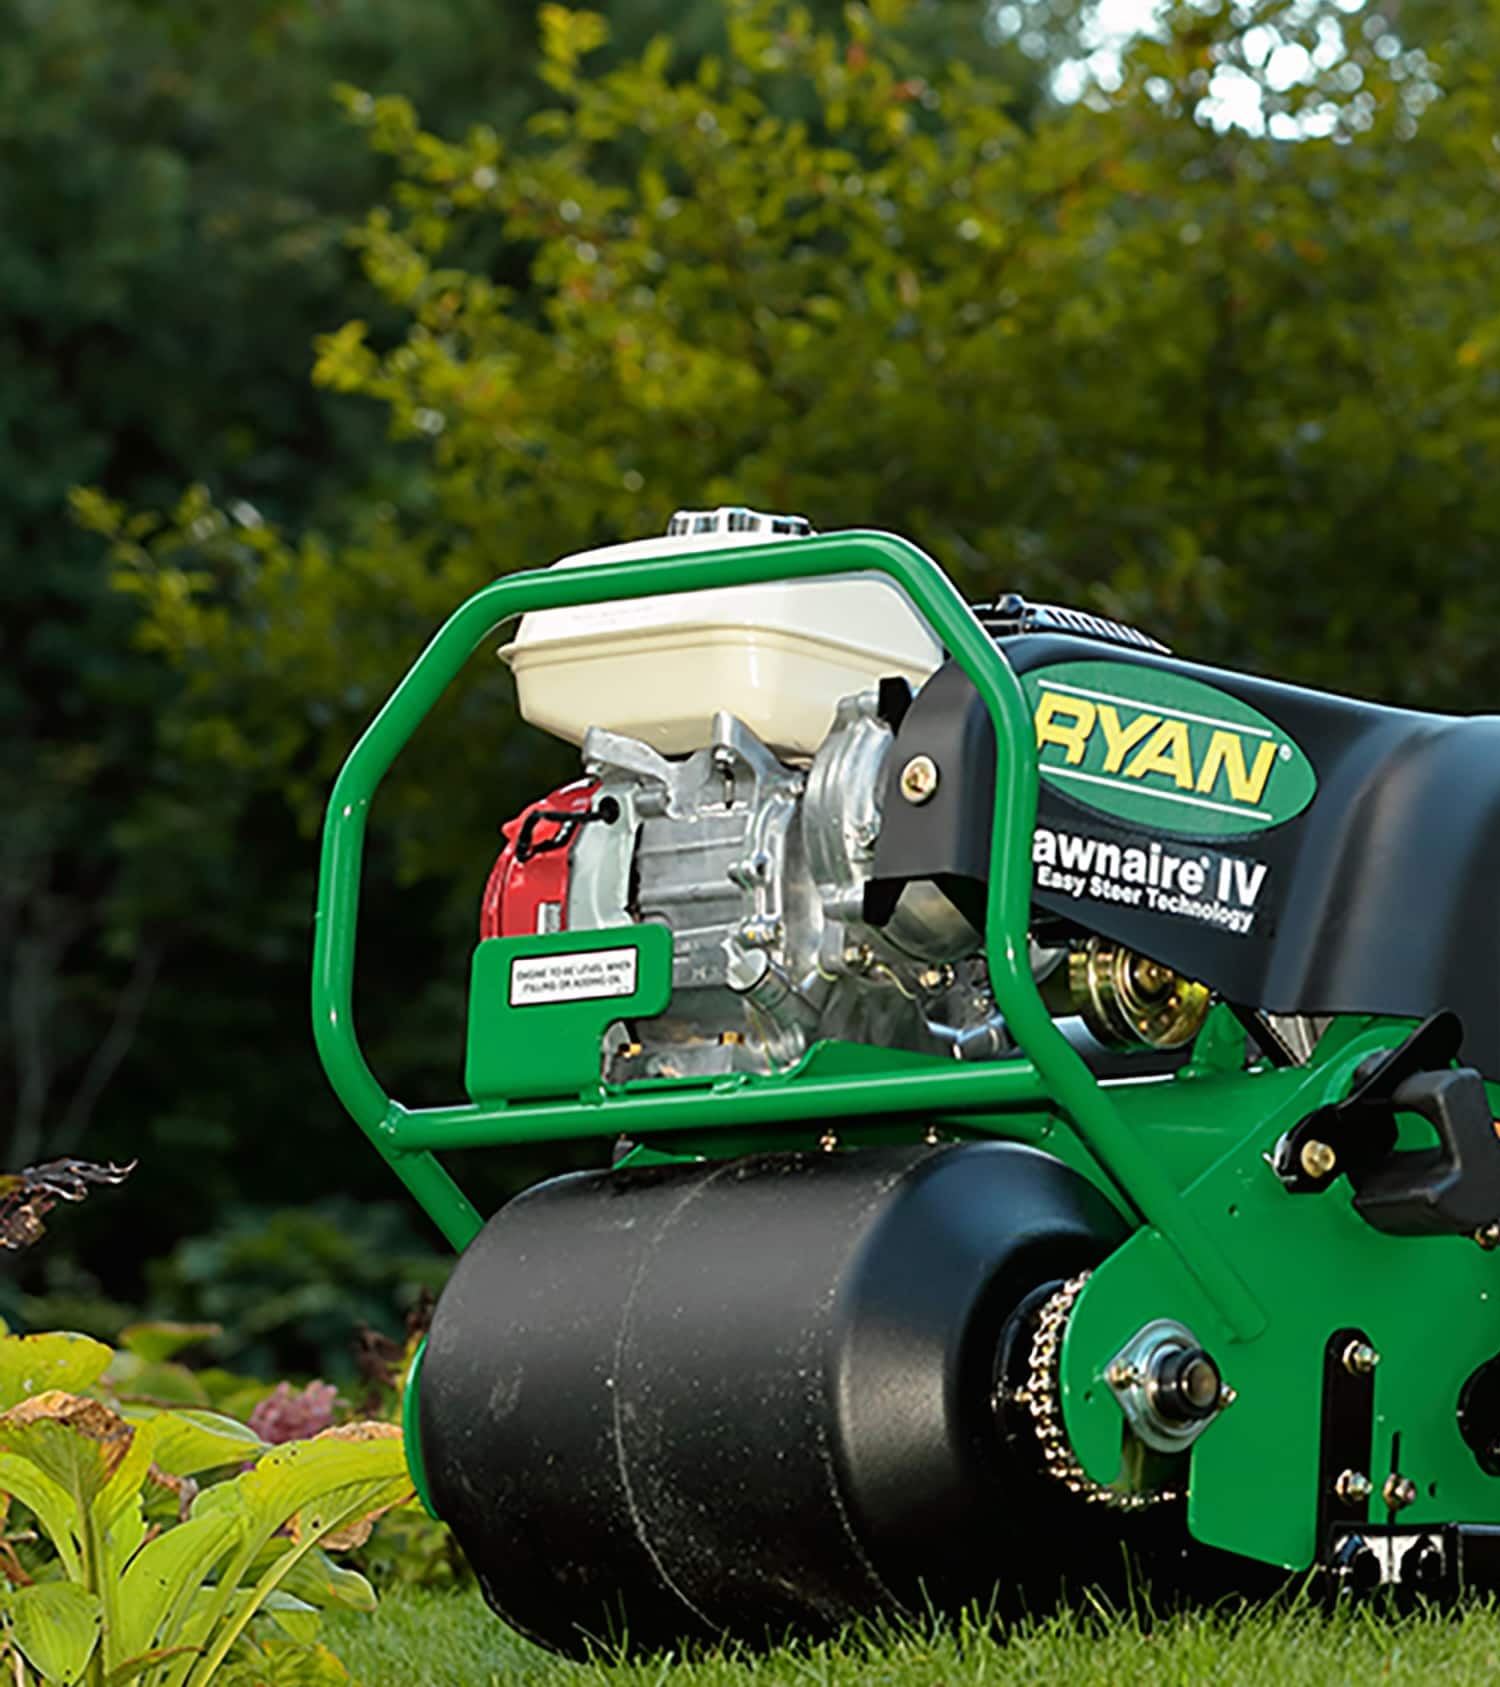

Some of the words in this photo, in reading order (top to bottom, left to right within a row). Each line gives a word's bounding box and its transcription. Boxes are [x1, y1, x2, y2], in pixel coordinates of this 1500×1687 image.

[1034, 691, 1278, 805] RYAN
[1031, 828, 1207, 896] awnaire
[1216, 857, 1268, 908] IV
[1036, 864, 1087, 898] Easy
[1089, 875, 1143, 905] Steer
[1145, 887, 1255, 934] Technology
